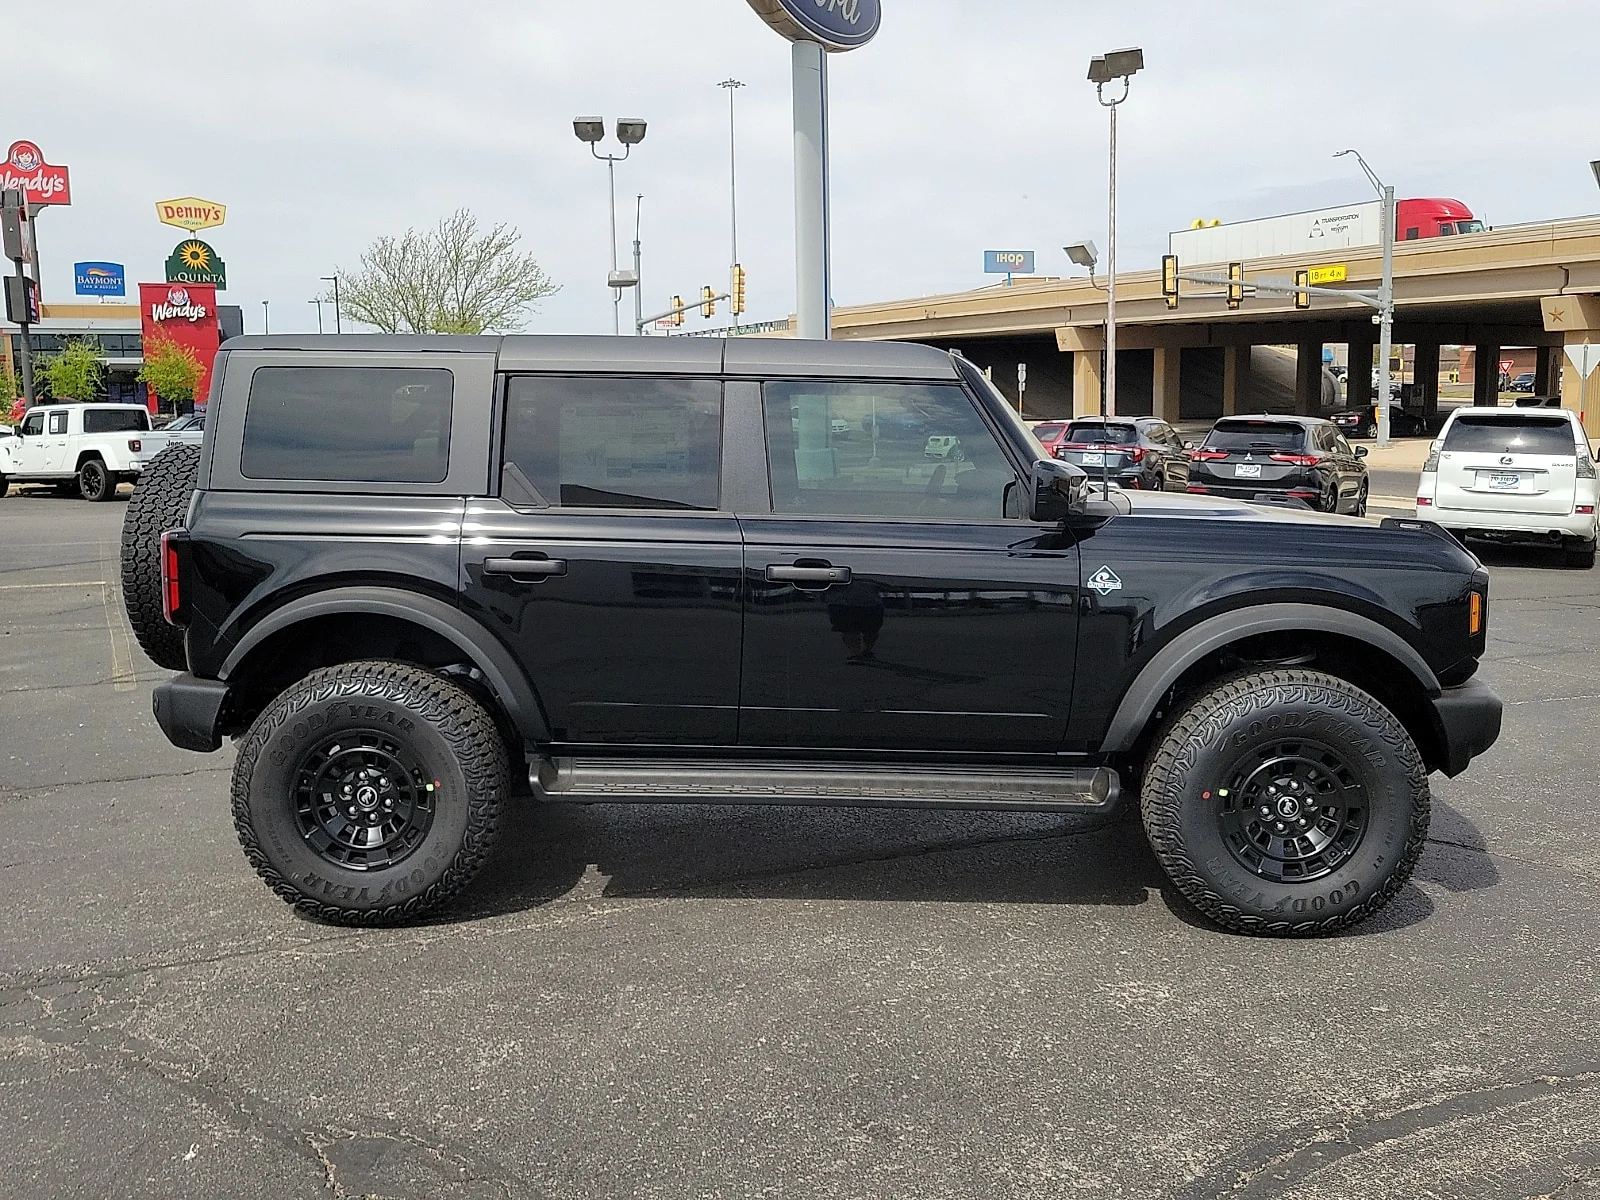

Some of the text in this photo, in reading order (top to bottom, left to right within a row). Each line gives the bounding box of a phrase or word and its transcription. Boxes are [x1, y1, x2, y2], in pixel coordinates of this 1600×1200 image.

[163, 205, 221, 221] Denny's
[1329, 269, 1335, 277] 4
[77, 275, 123, 285] BAYMONT
[151, 302, 207, 322] Wendy's
